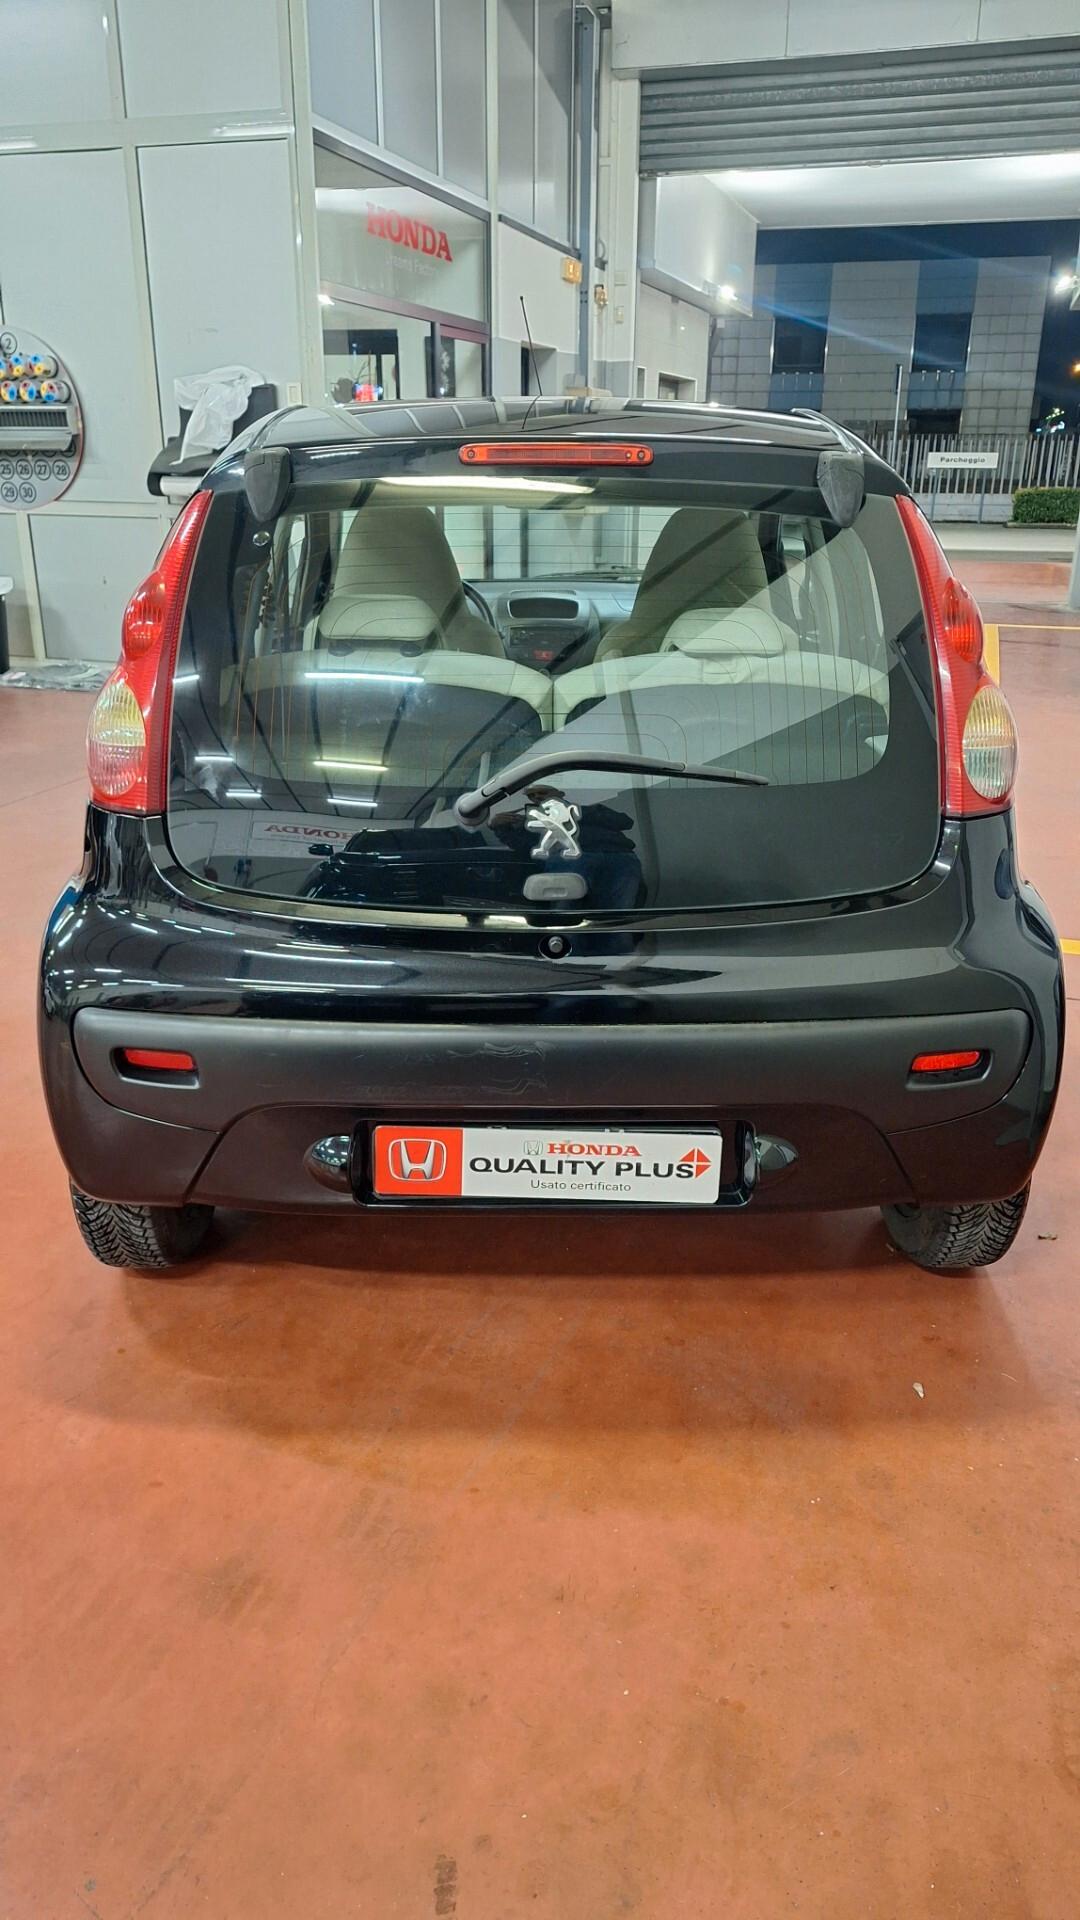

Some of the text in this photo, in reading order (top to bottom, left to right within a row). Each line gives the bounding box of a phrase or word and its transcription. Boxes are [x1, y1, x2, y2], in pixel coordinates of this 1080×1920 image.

[366, 202, 453, 262] HONDA
[940, 456, 985, 465] Parcheggio
[0, 463, 68, 476] 25 26 27 28
[4, 486, 34, 498] 29 30
[547, 1142, 642, 1157] HONDA
[469, 1157, 695, 1179] QUALITY PLUS
[530, 1179, 632, 1192] Usato certificato
